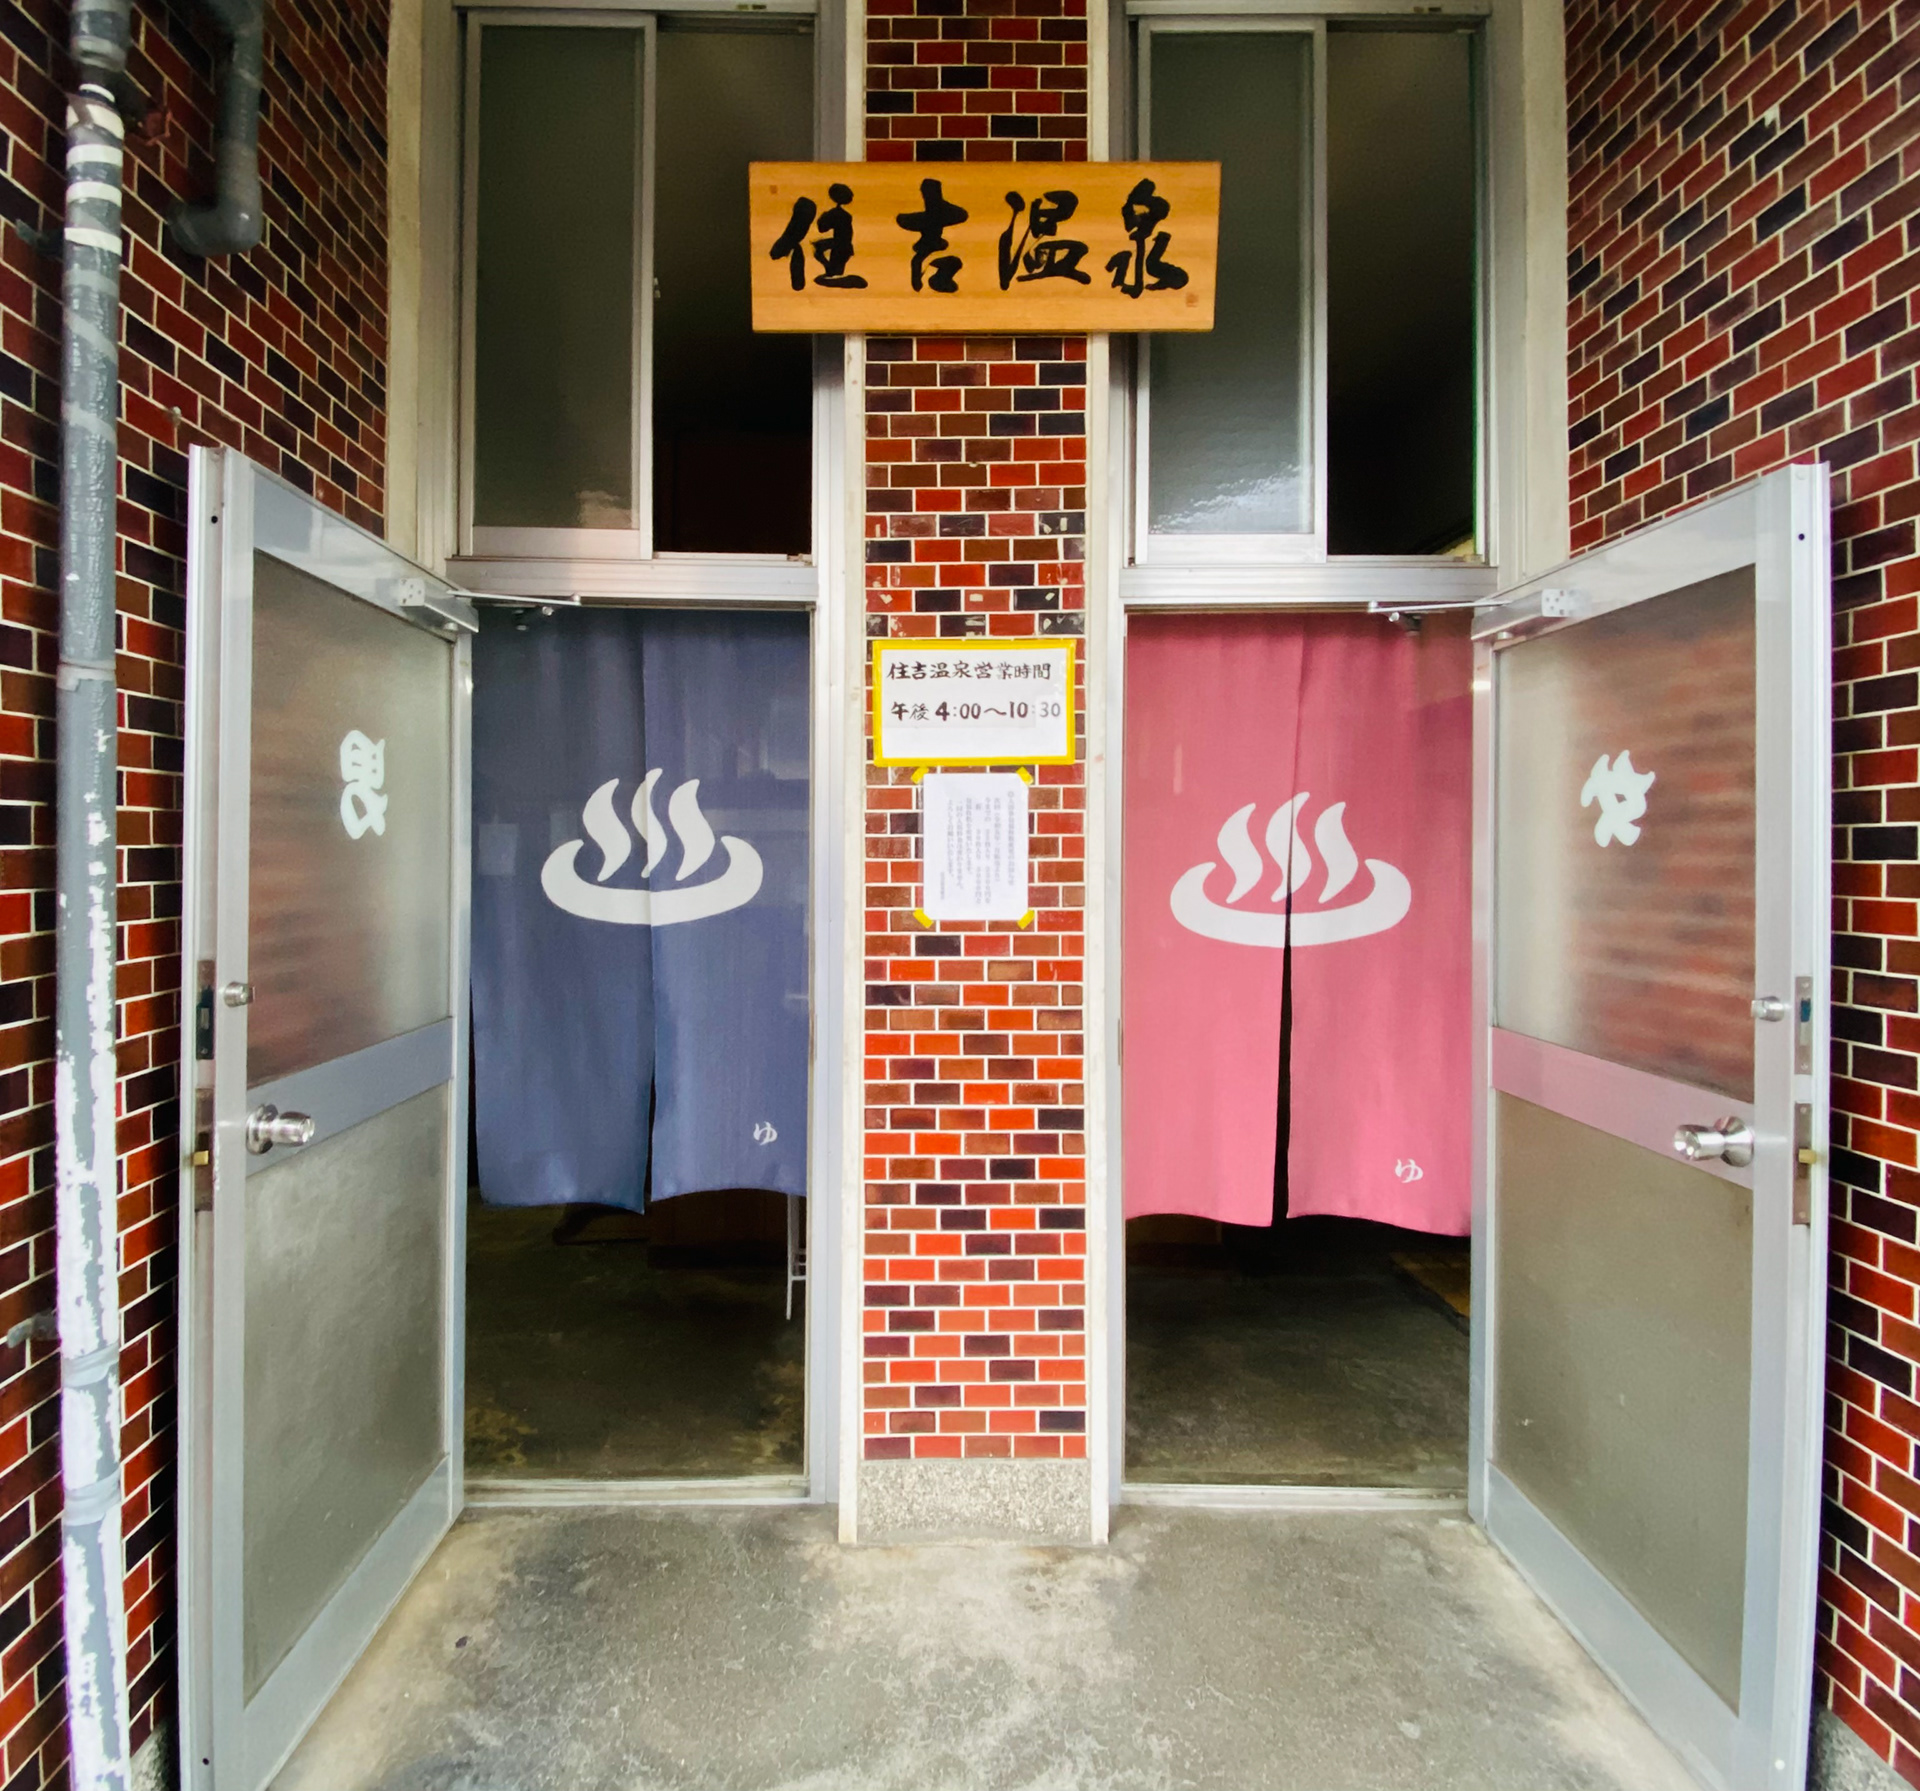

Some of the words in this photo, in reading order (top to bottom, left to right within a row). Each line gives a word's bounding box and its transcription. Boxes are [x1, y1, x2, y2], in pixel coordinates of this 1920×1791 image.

[770, 178, 1189, 299] 住吉温泉
[886, 660, 1051, 680] 住吉温泉営業時間
[753, 1121, 778, 1146] ゆ
[1394, 1158, 1424, 1184] ゆ
